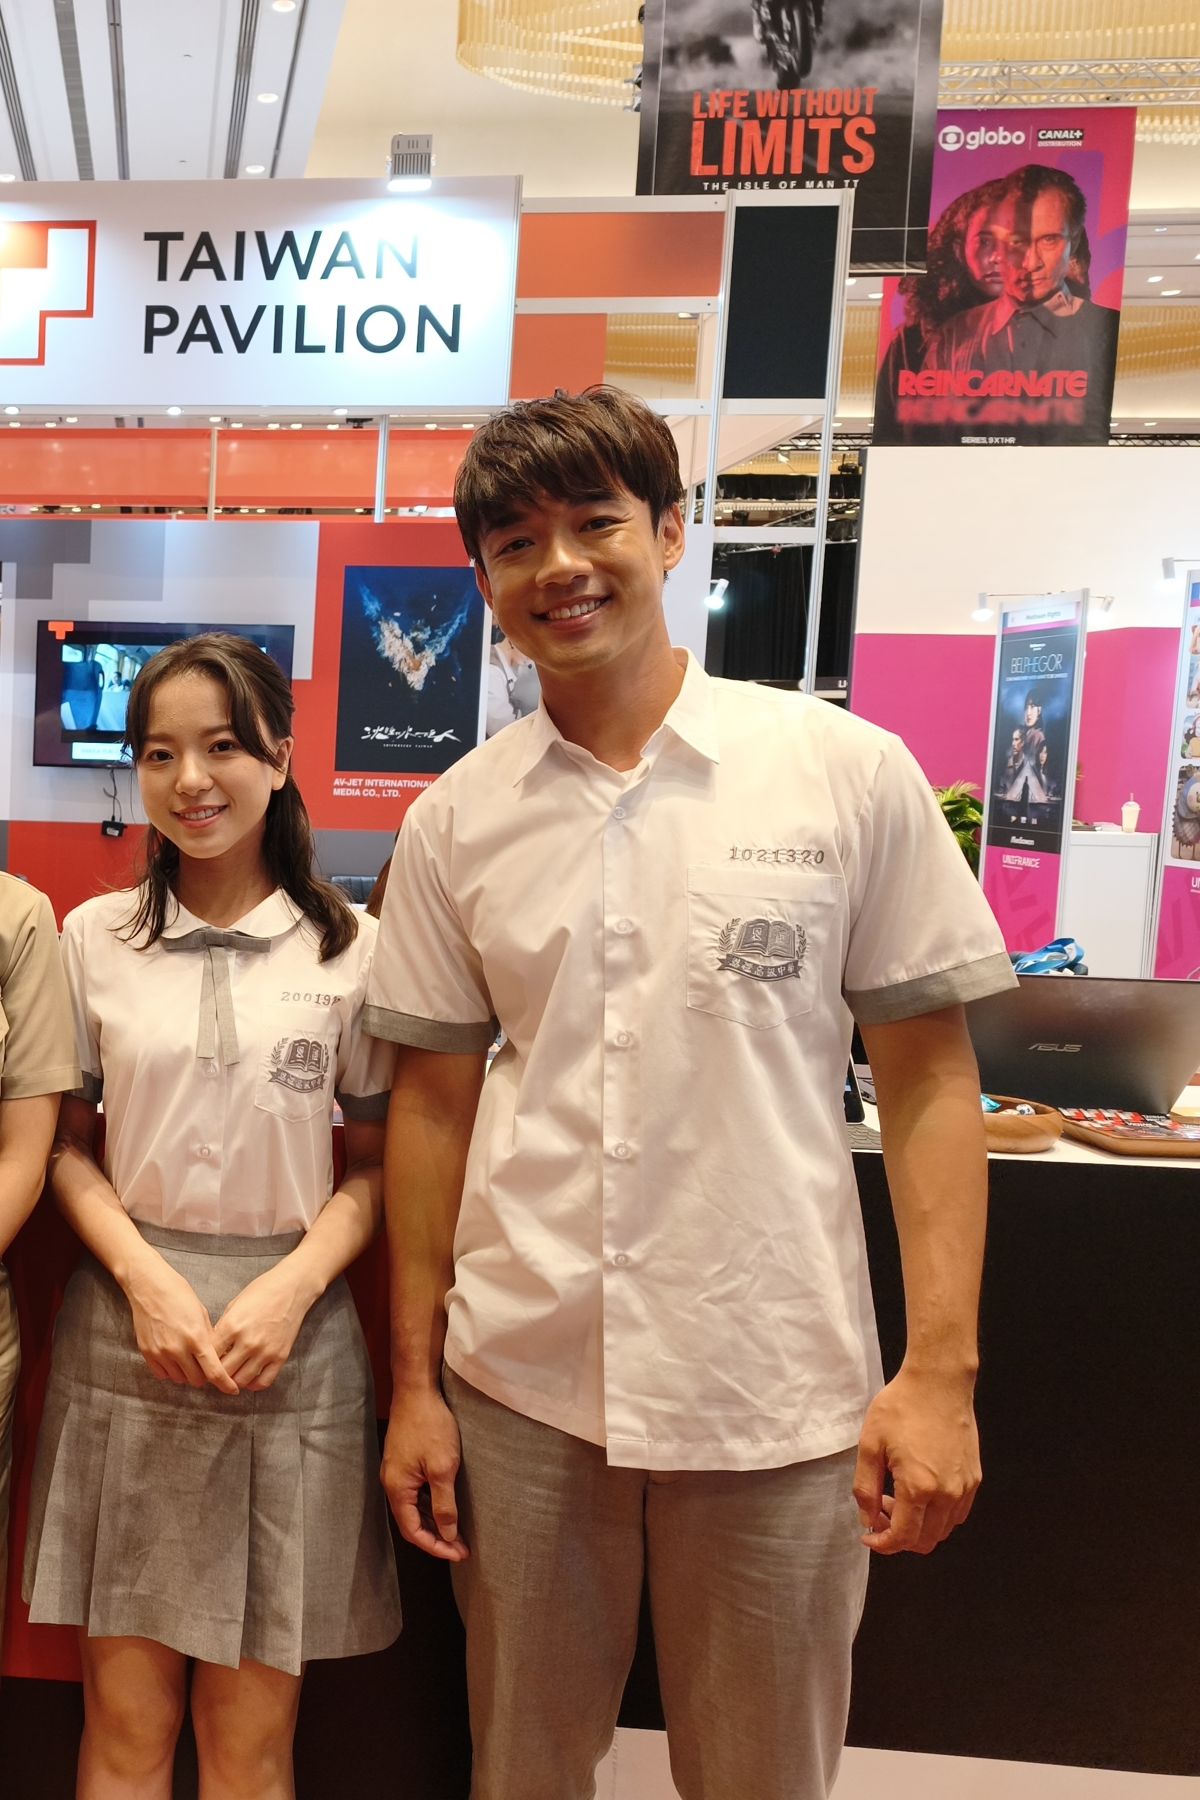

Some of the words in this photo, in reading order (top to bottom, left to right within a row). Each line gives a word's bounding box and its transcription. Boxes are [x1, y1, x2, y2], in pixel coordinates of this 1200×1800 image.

[693, 90, 749, 118] LIFE
[755, 87, 879, 117] WITHOUT
[966, 126, 1026, 150] globo
[1038, 129, 1083, 140] CANAL+
[690, 117, 876, 176] LIMITS
[703, 182, 729, 190] THE
[737, 181, 770, 190] ISLE
[778, 181, 797, 189] OF
[805, 180, 835, 188] MAN
[843, 179, 860, 188] TT
[144, 230, 419, 282] TAIWAN
[144, 304, 461, 354] PAVILION
[897, 369, 1089, 398] REINCARNATE
[1011, 653, 1063, 673] BELPHEGOR
[333, 778, 363, 787] AV-JET
[333, 788, 360, 797] MEDIA
[382, 789, 401, 798] LTD.
[729, 846, 825, 864] 1021320
[1002, 854, 1040, 868] UNIFRANCE
[1028, 1043, 1083, 1053] ASUS
